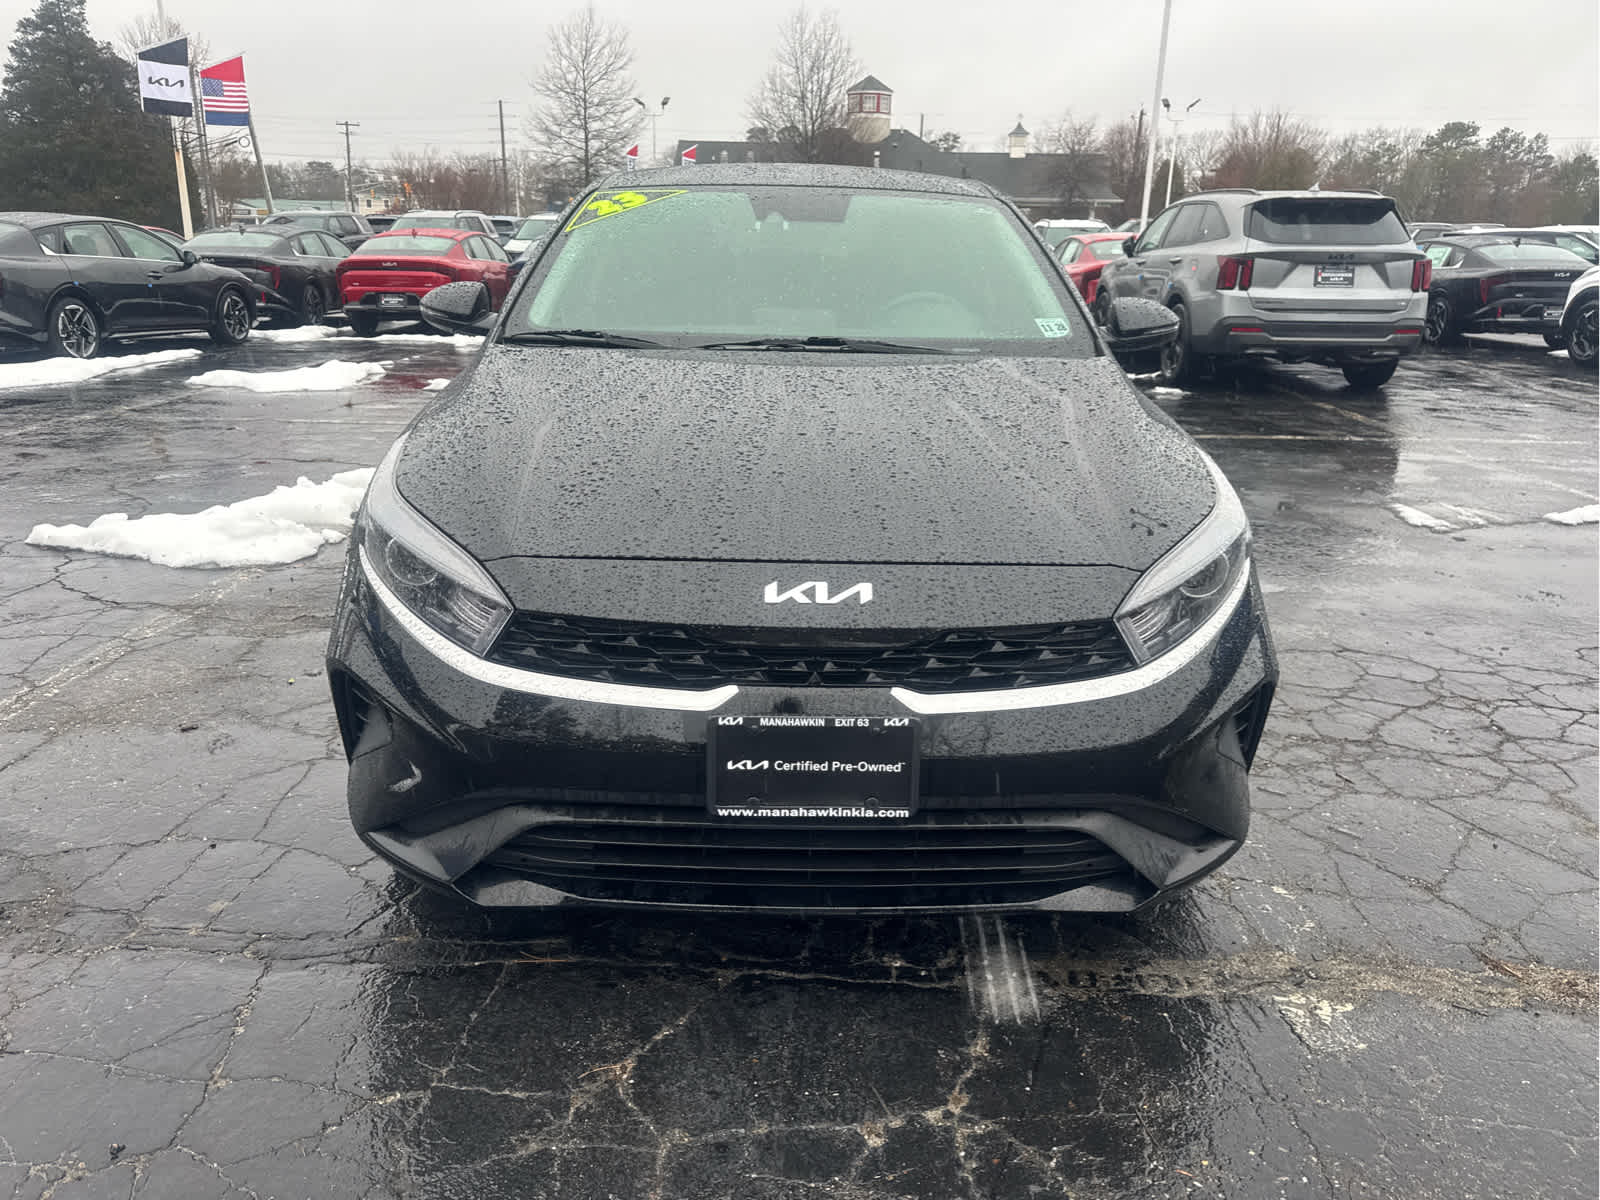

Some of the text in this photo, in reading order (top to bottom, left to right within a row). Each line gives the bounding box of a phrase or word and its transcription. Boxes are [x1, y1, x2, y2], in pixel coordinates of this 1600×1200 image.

[148, 76, 184, 88] KIA
[764, 581, 873, 605] KIA
[718, 717, 909, 727] KIA MANAHAWKIN EXIT 63 KIA
[727, 760, 902, 772] KIA Certified Pre-Owned
[717, 807, 910, 818] www.manahawkinkia.com
